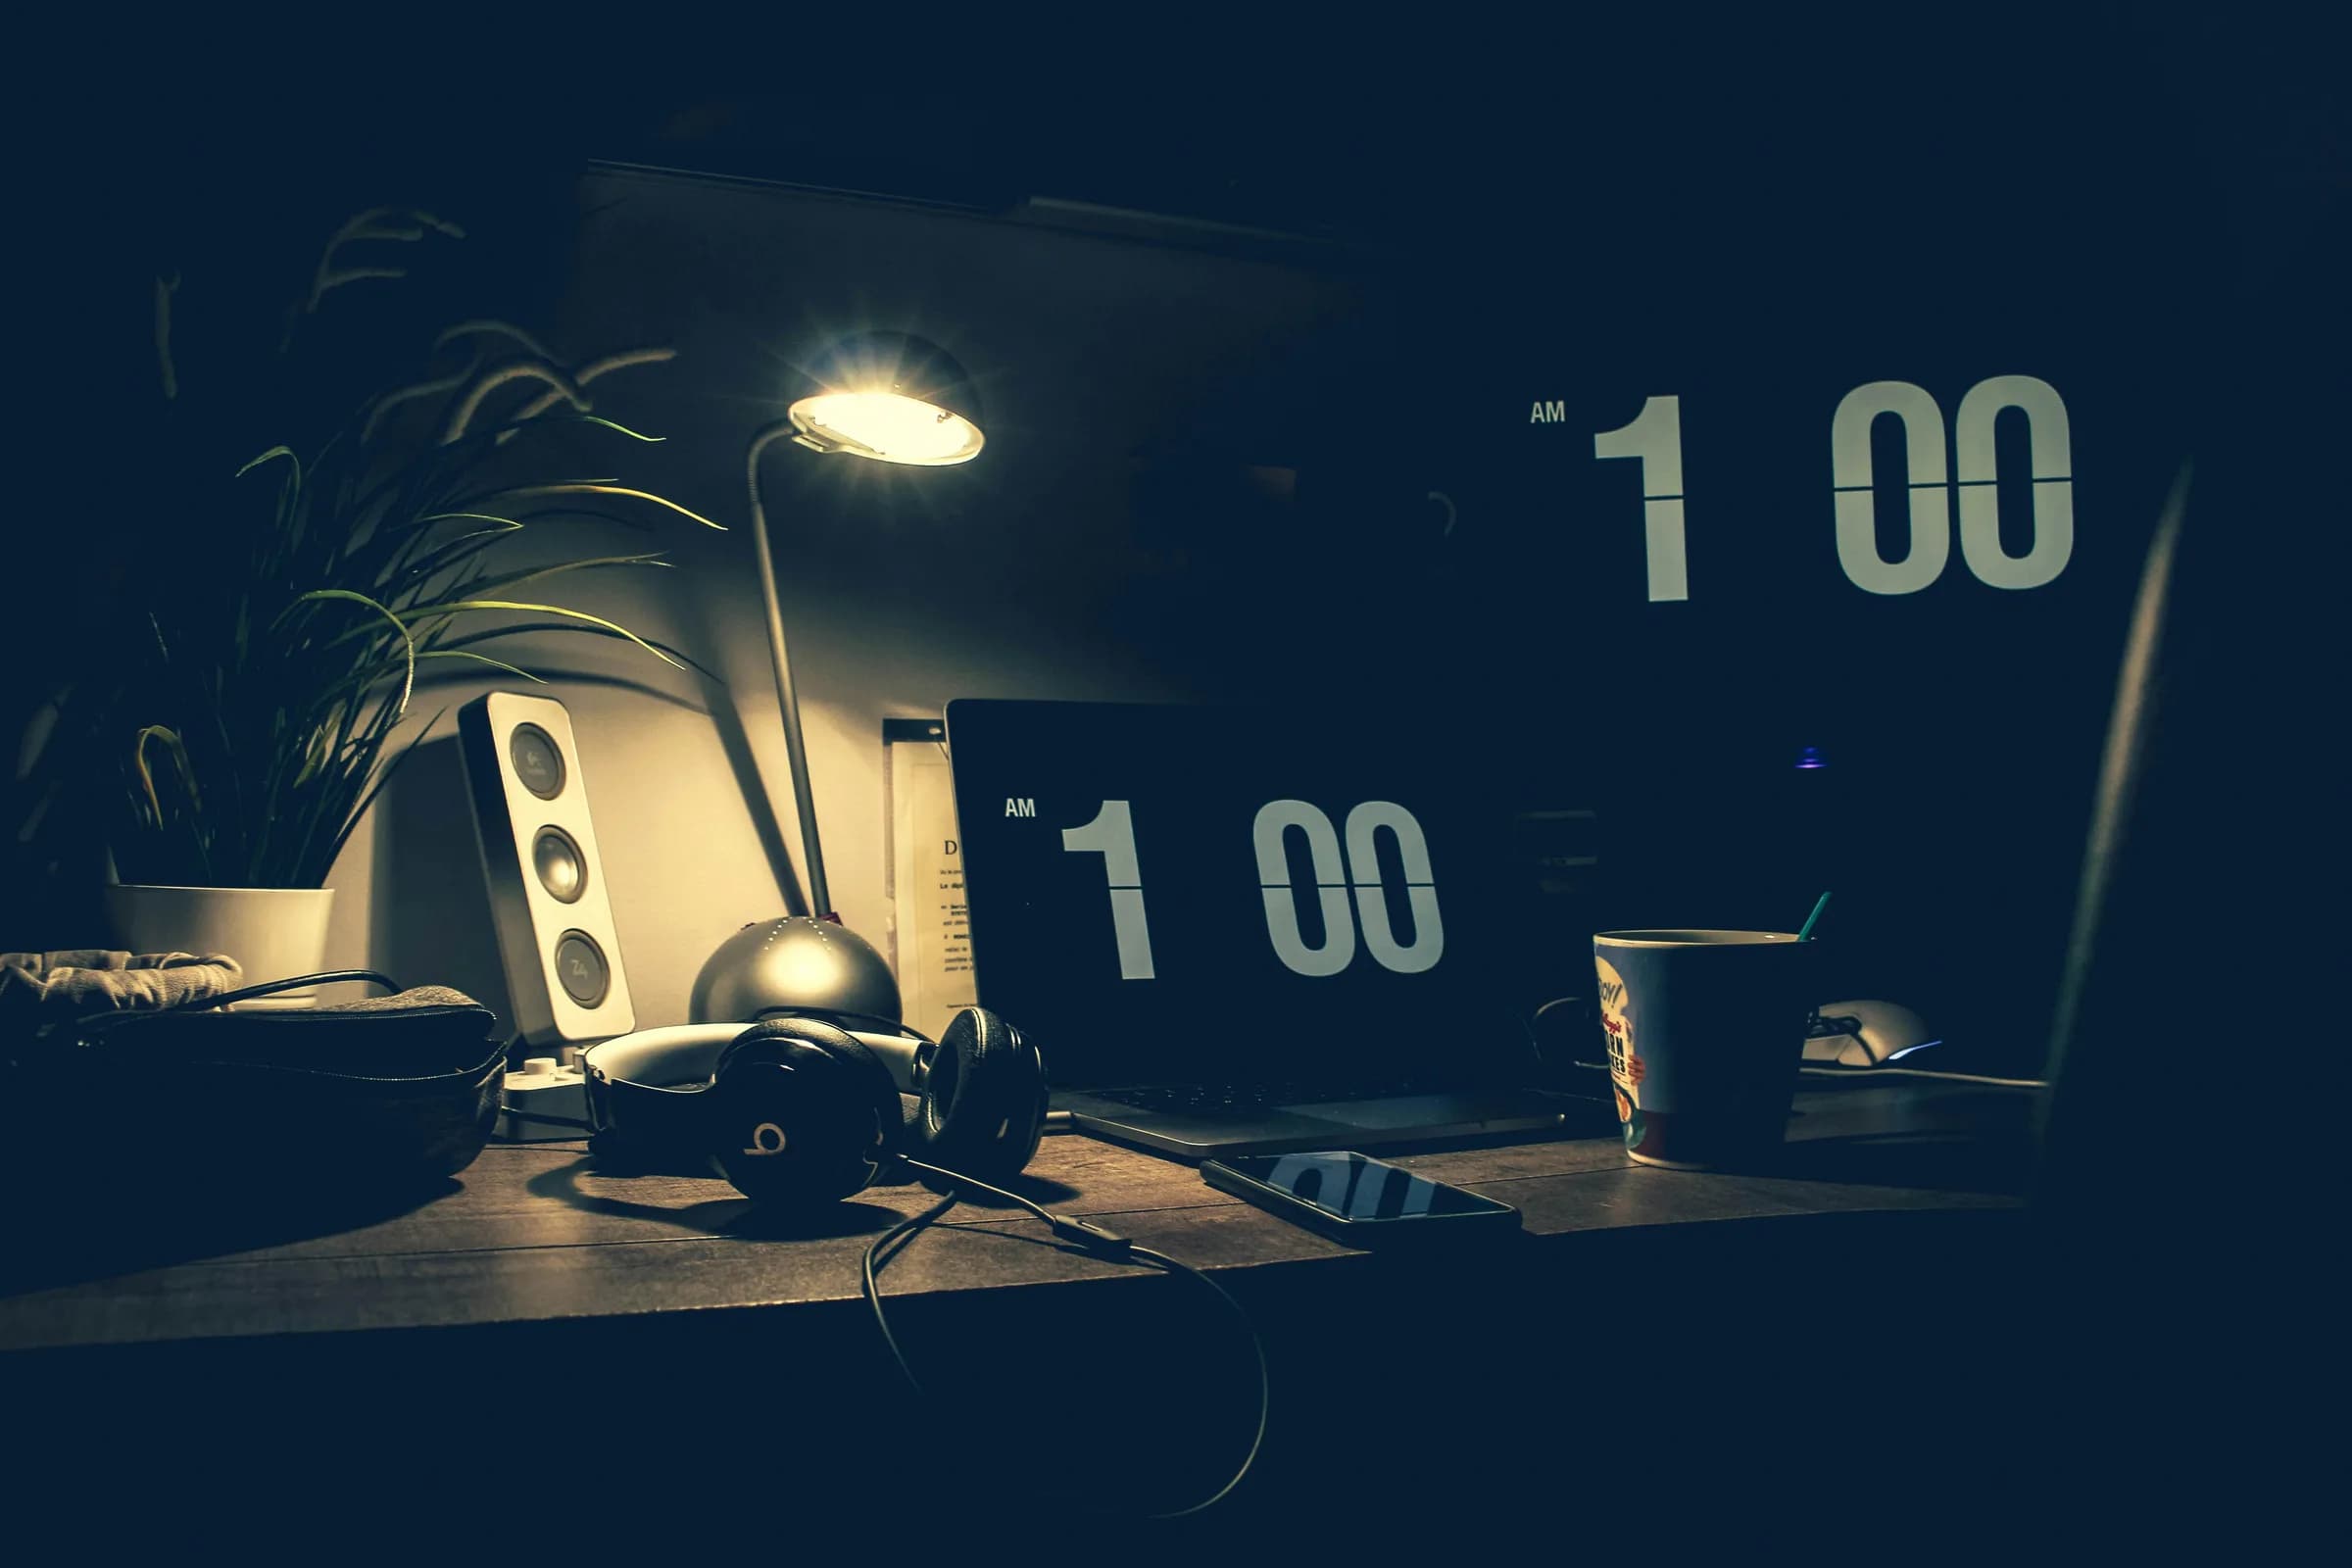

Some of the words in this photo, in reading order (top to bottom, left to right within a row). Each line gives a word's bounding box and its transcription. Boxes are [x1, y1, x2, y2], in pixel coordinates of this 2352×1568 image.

[1530, 400, 1566, 424] AM
[1593, 395, 1689, 603] 1
[1832, 374, 2074, 595] 00
[1004, 798, 1036, 817] AM
[1061, 800, 1155, 980] 1
[1252, 799, 1445, 977] 00
